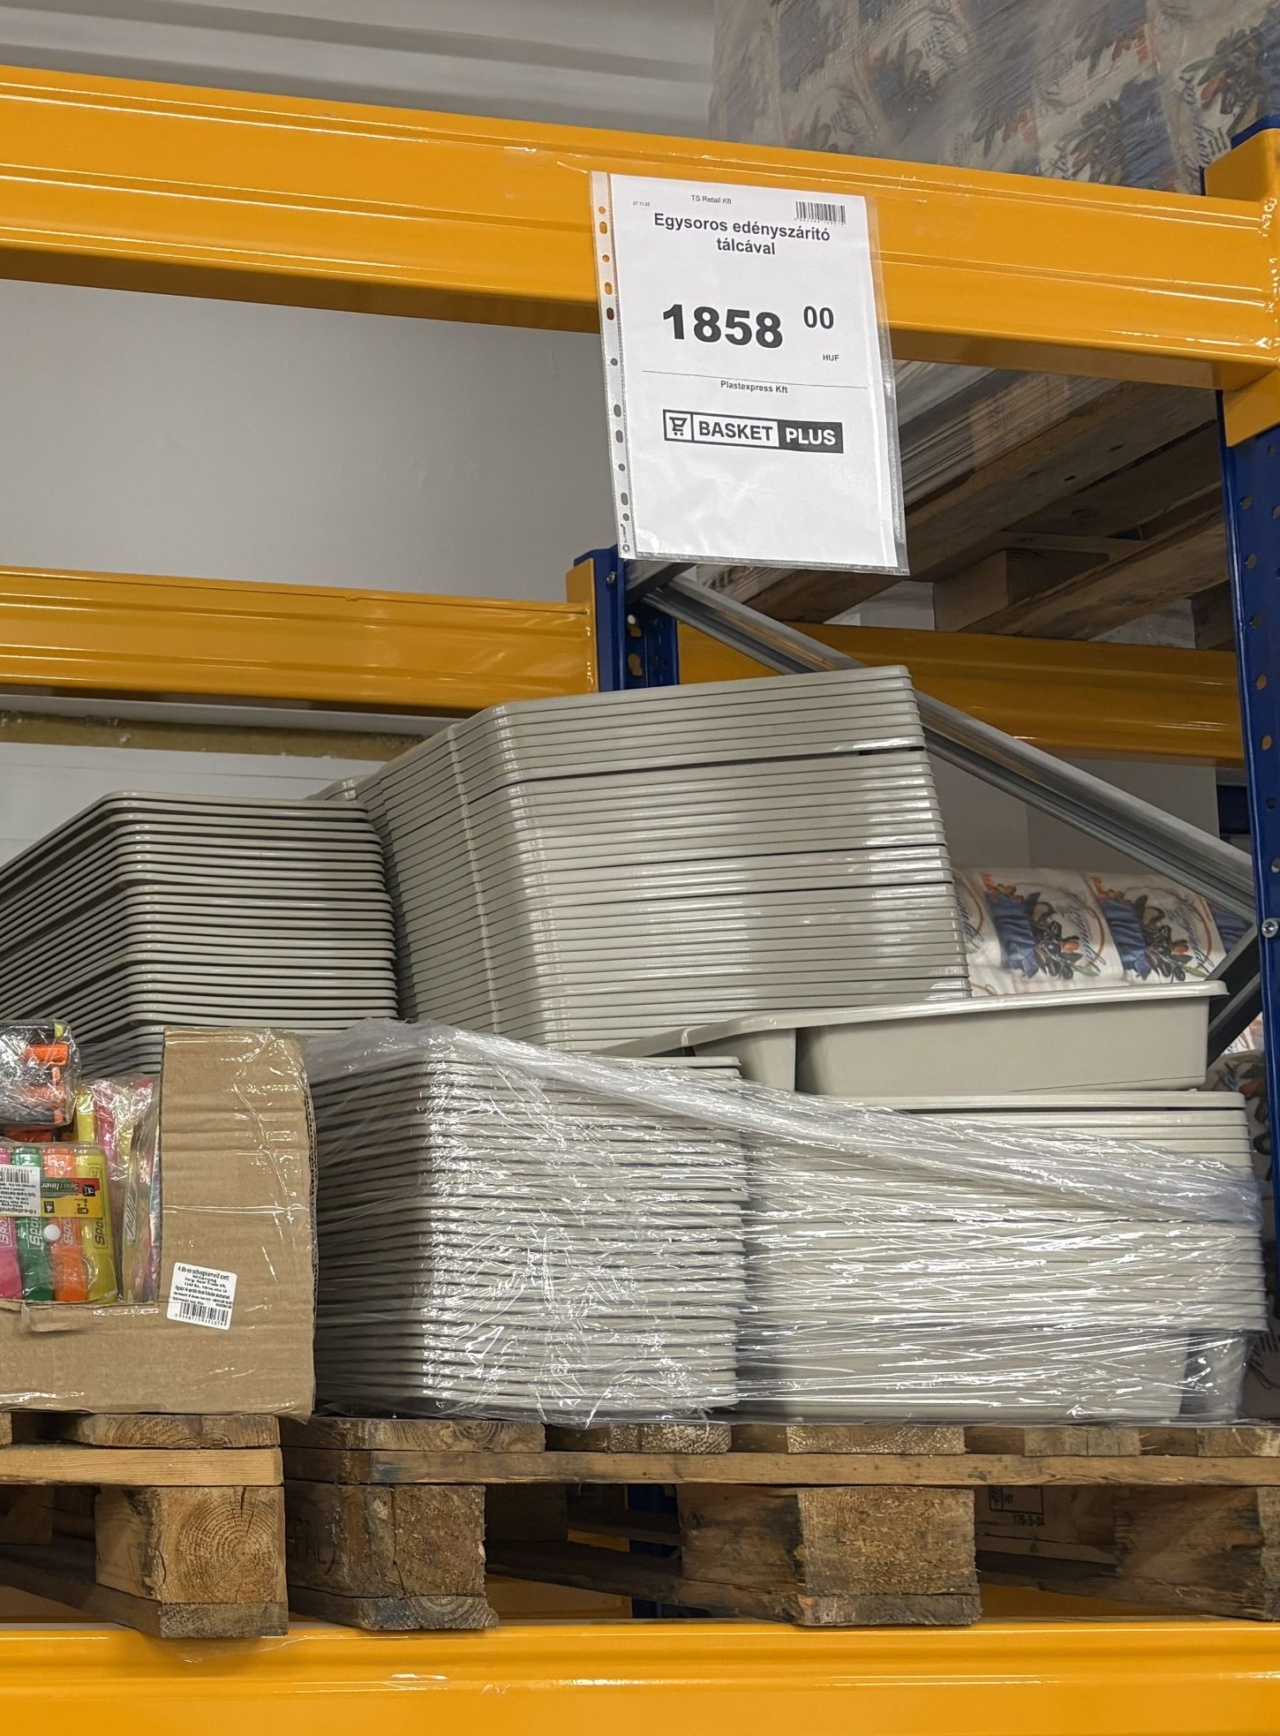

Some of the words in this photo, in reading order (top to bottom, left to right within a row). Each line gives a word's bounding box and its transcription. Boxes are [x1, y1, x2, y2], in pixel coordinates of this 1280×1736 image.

[691, 194, 701, 202] TS
[702, 196, 721, 204] Retail
[654, 212, 728, 231] Egysoros
[732, 220, 831, 242] edényszárító
[716, 237, 776, 255] tálcával
[662, 303, 783, 349] 1858
[803, 305, 835, 330] 00
[822, 353, 840, 362] HUF
[720, 380, 774, 393] Plastexpress
[775, 384, 788, 394] Kft
[698, 420, 774, 442] BASKET
[785, 427, 836, 446] PLUS
